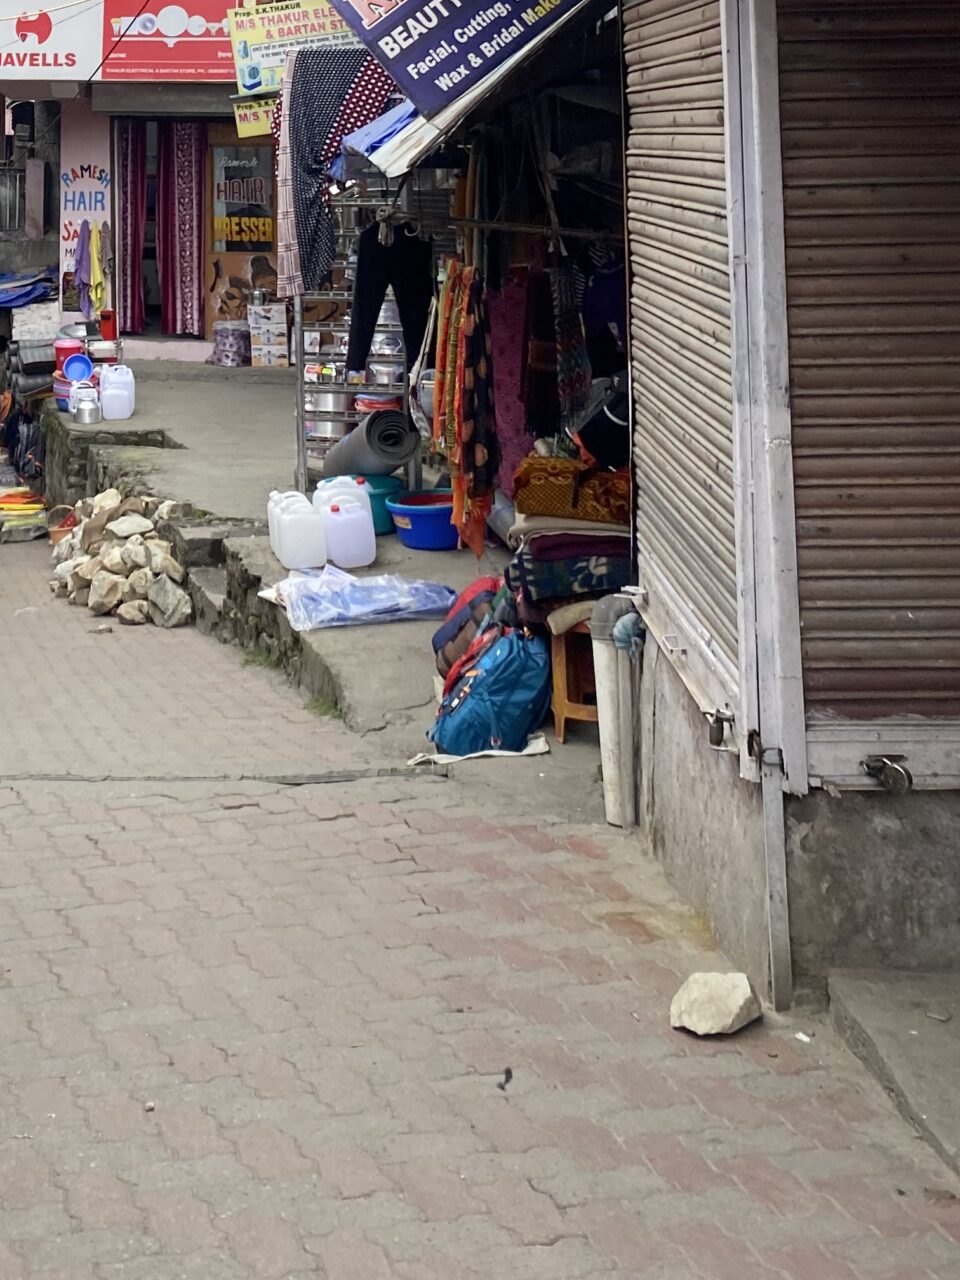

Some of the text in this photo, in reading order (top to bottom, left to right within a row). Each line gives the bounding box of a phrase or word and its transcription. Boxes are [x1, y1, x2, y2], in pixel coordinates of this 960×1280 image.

[234, 11, 253, 20] Prop.
[235, 18, 256, 31] M/S
[259, 9, 310, 27] THAKUR
[265, 20, 345, 40] & BARTAN ST
[407, 41, 459, 80] Facial,
[454, 1, 512, 45] Cutting,
[435, 68, 471, 92] Wax
[470, 52, 484, 69] &
[480, 20, 525, 59] Bridal
[237, 100, 277, 111] Prop. S.K.T
[238, 111, 260, 122] M/S
[220, 156, 259, 168] Ramesh
[61, 164, 111, 188] RAMESH
[63, 190, 106, 211] HAIR
[215, 176, 266, 205] HAIR
